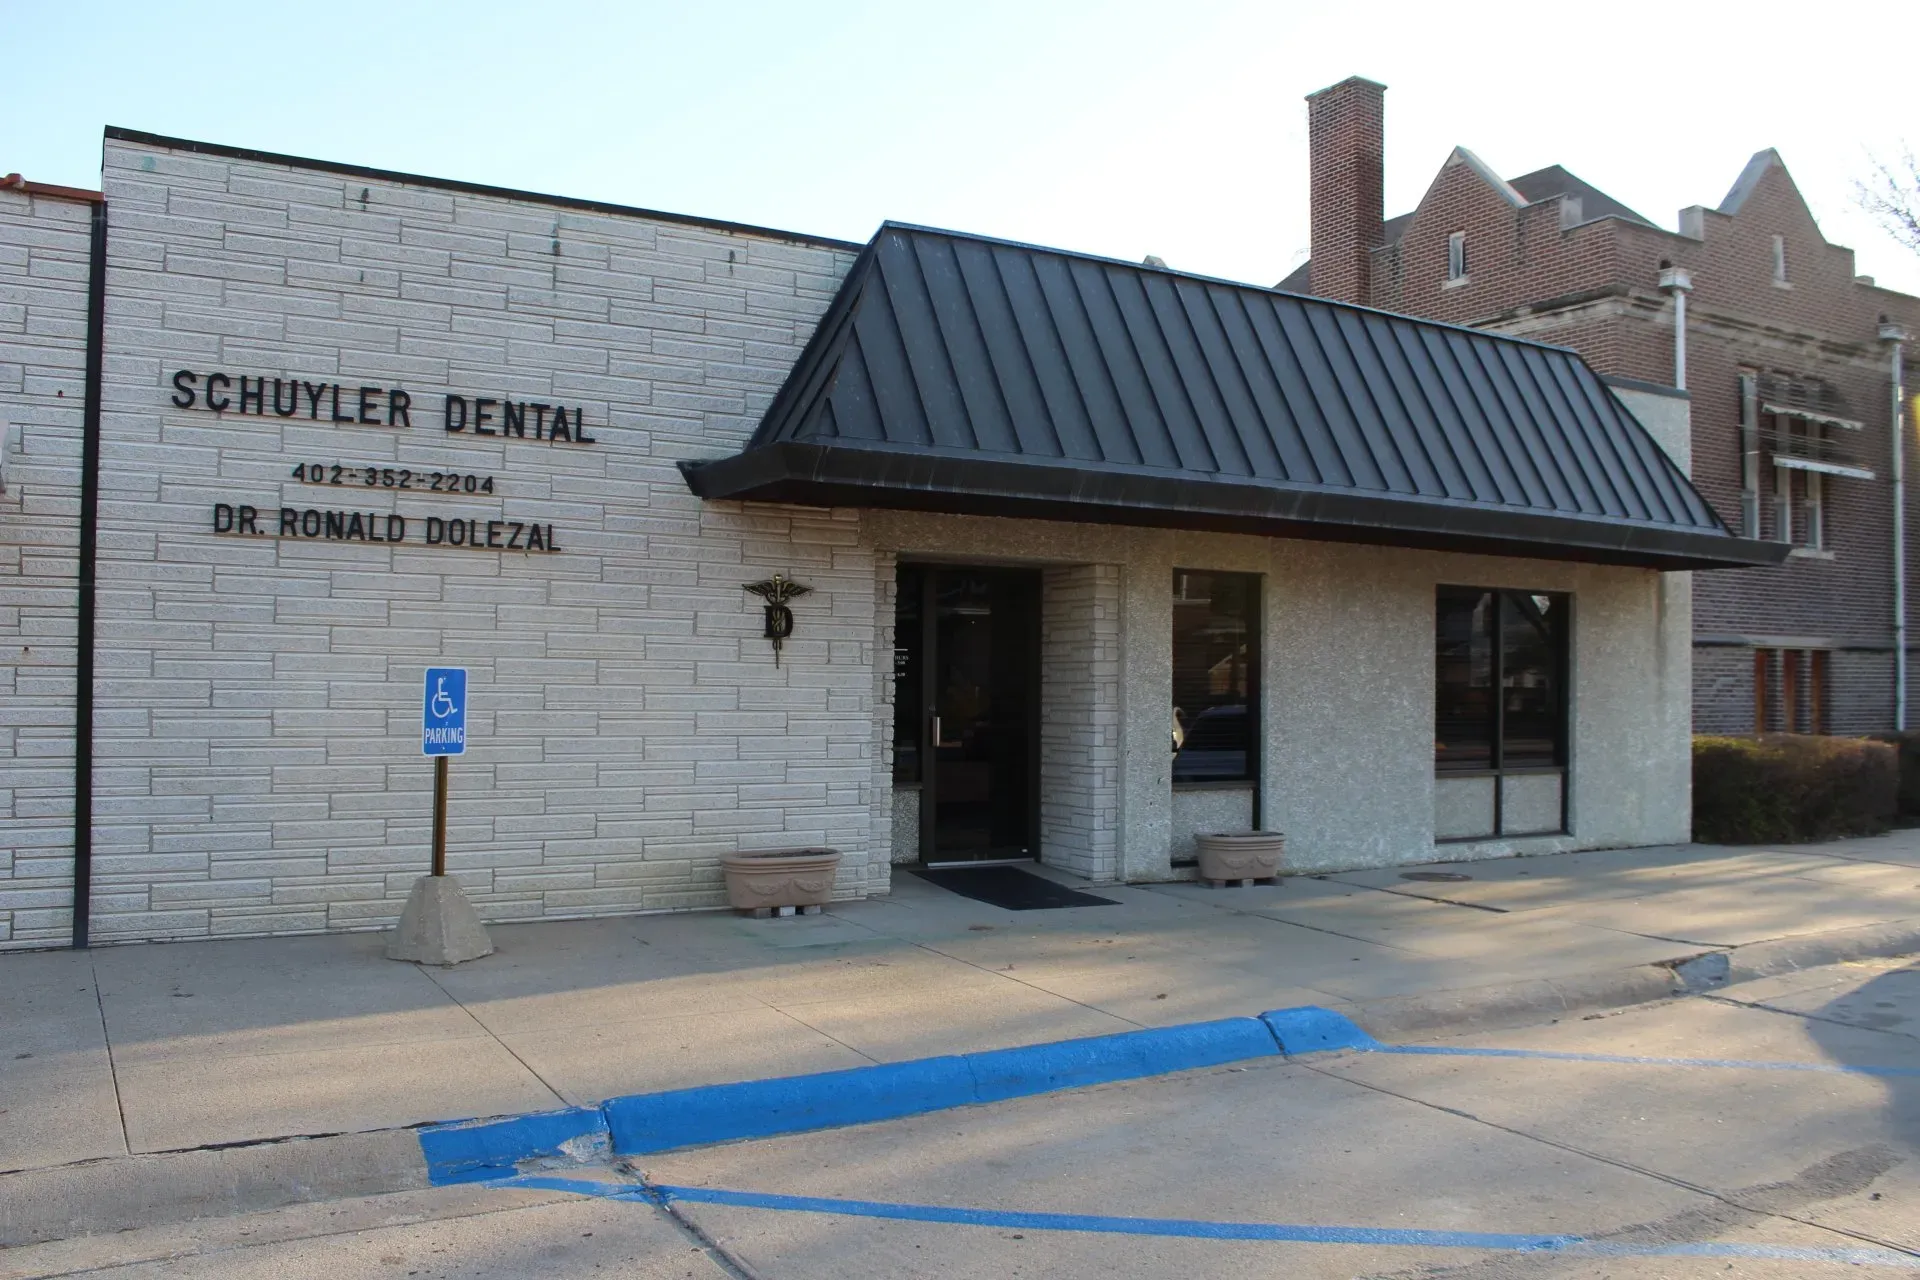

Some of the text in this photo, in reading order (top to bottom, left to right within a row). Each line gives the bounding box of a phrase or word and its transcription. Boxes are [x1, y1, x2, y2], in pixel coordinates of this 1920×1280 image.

[171, 370, 596, 443] SCHUYLER DENTAL
[292, 463, 494, 494] 402-352-2204
[214, 503, 562, 552] DR. RONALD DOLEZAL
[425, 727, 464, 744] PARKING
